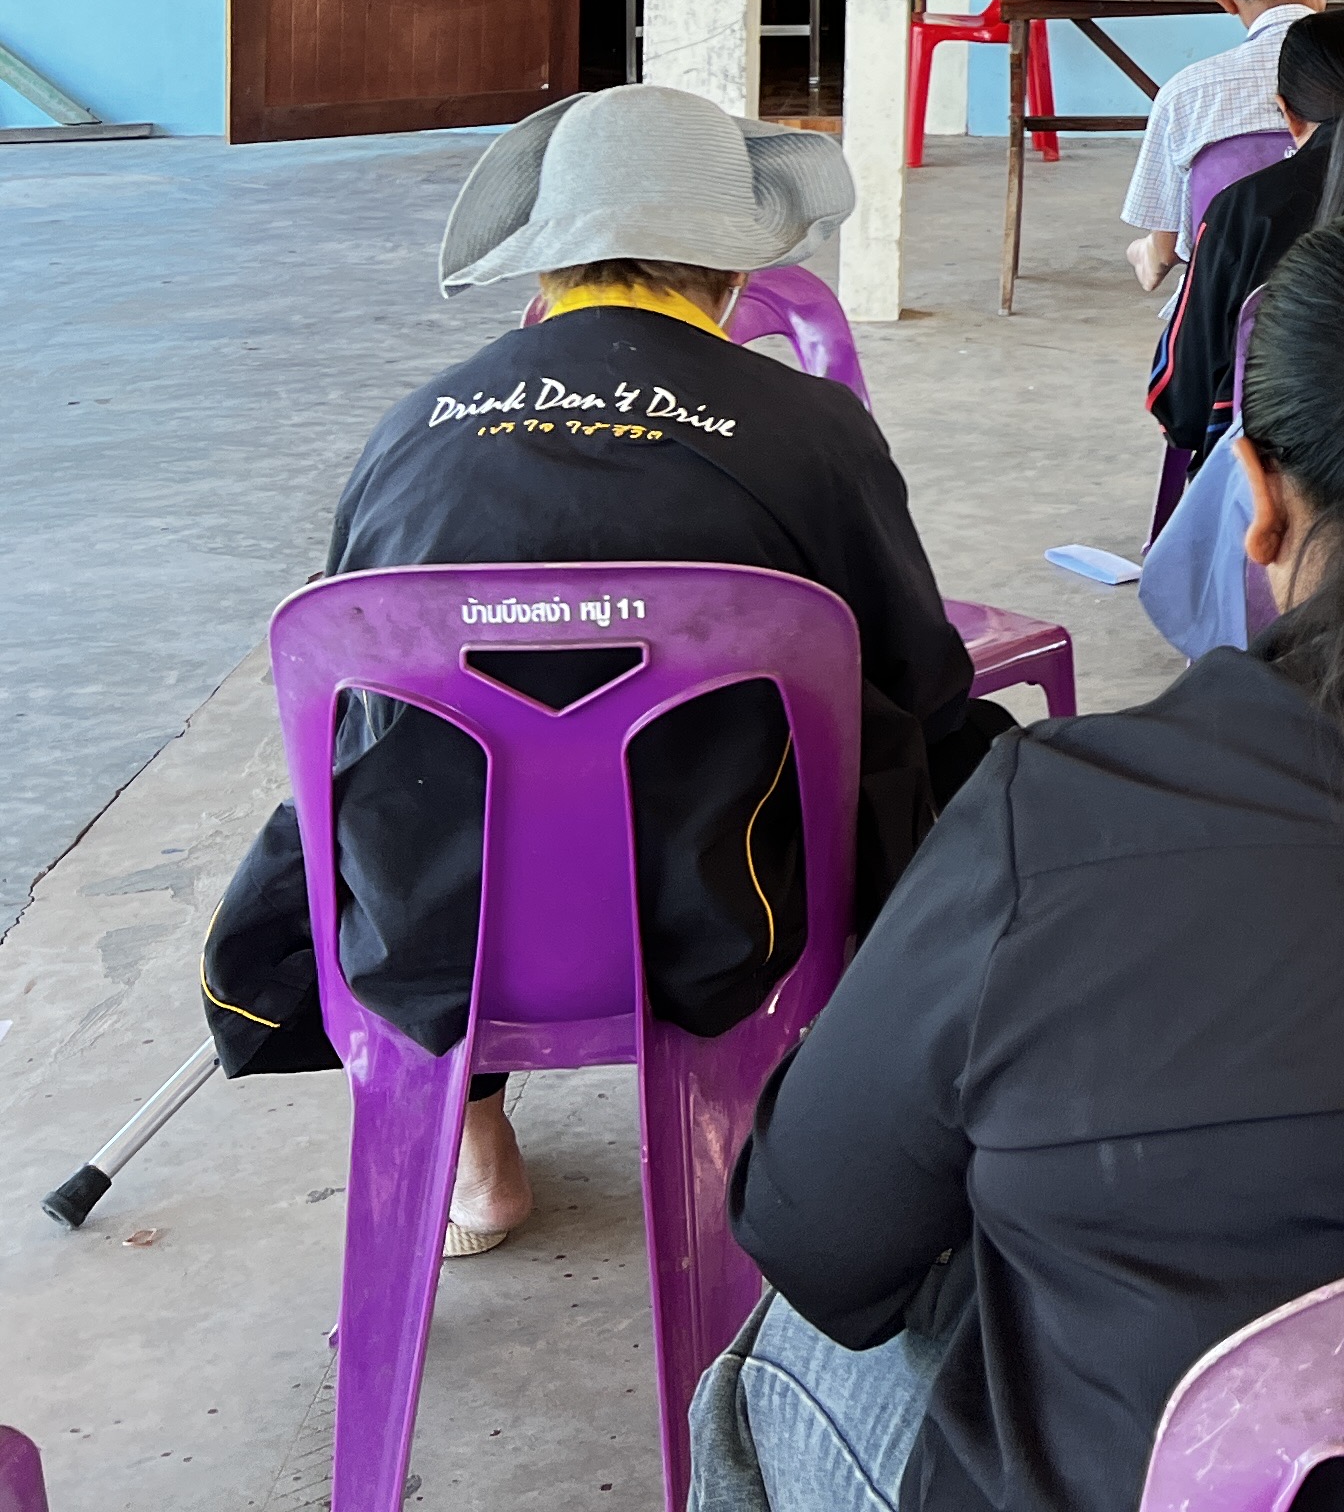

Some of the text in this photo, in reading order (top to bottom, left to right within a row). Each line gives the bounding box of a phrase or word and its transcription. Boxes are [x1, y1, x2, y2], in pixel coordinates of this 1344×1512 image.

[429, 381, 526, 427] Drink
[646, 386, 737, 437] Drive
[461, 595, 645, 627] บ้านบึงสง่า หมู่ 11
